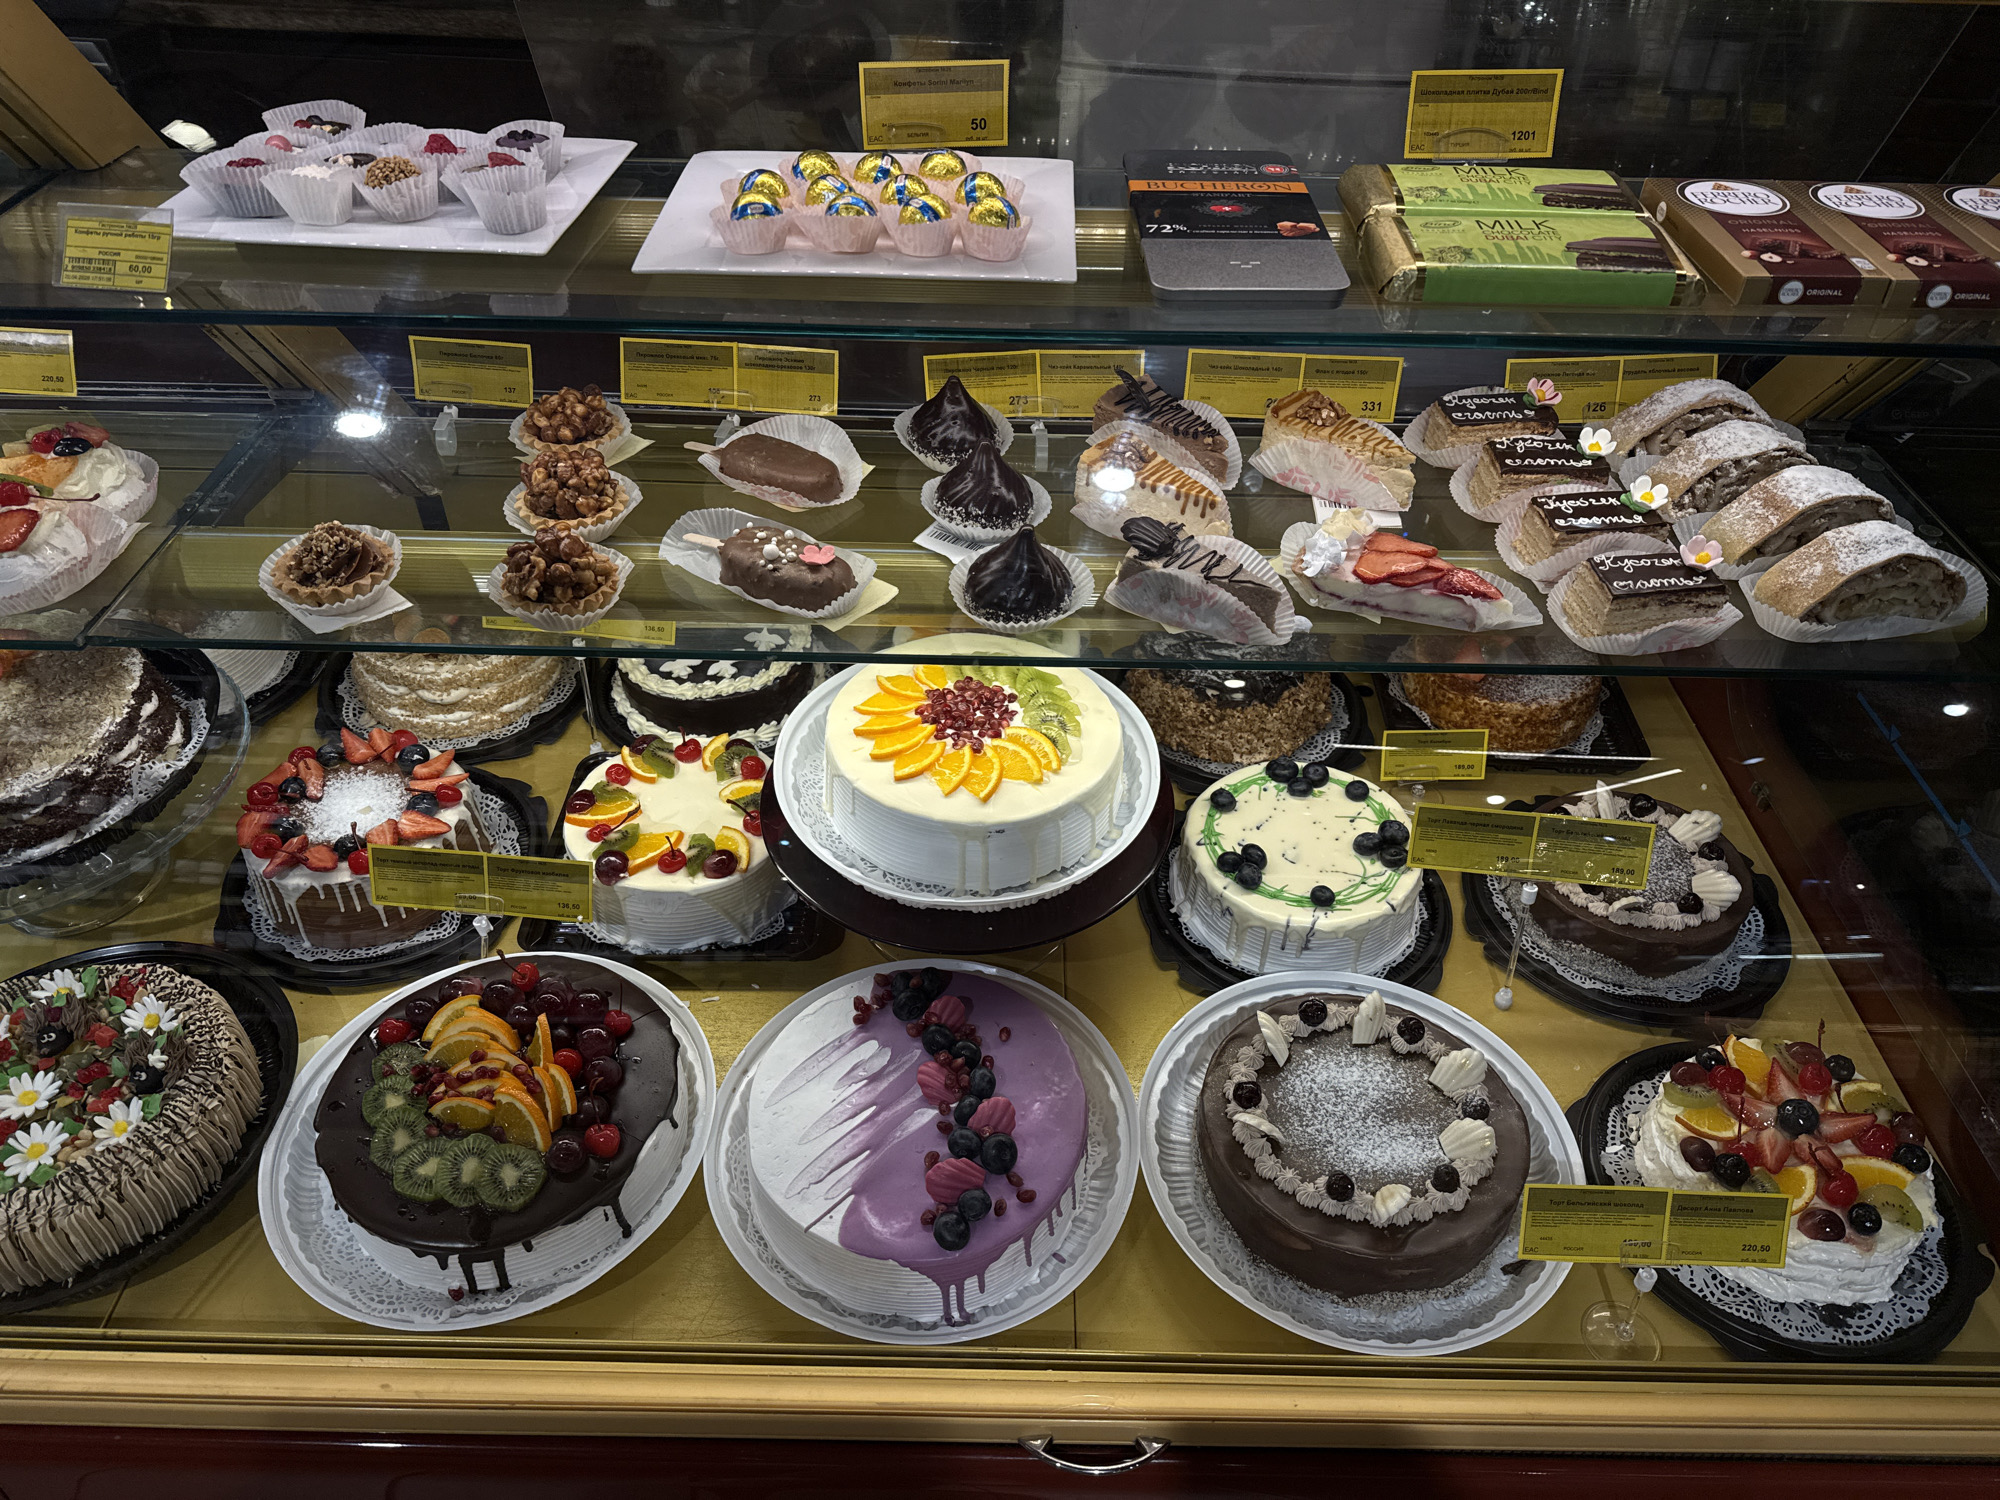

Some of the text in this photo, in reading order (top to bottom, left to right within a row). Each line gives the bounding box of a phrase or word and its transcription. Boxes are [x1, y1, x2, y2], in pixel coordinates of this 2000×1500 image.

[893, 80, 926, 88] Конфеты
[1420, 88, 1465, 97] Шоколадная
[1466, 88, 1491, 96] плитка
[1491, 88, 1514, 97] Дубай
[970, 117, 987, 131] 50
[869, 135, 883, 143] EAC
[1511, 129, 1536, 141] 1201
[1453, 166, 1528, 177] MILK
[1146, 181, 1292, 192] BUCHERON
[1690, 191, 1771, 200] FERRERO
[1823, 194, 1904, 203] FERRERO
[1695, 198, 1780, 206] ROCHER
[1832, 200, 1915, 209] ROCHER
[1145, 224, 1188, 234] 72%
[1474, 219, 1557, 231] MILK
[74, 229, 101, 237] Конфеты
[102, 230, 123, 239] ручной
[128, 264, 152, 274] 60,00
[636, 352, 665, 360] Пирожное
[41, 375, 64, 383] 220,50
[503, 386, 516, 394] 137
[808, 394, 821, 402] 273
[1008, 395, 1029, 406] 273
[1361, 400, 1382, 412] 331
[1586, 401, 1607, 413] 126
[644, 625, 665, 633] 136,50
[1490, 822, 1524, 831] смородина
[1551, 827, 1565, 835] Торт
[1611, 866, 1635, 876] 189,00
[557, 902, 581, 911] 136,50
[1549, 1199, 1566, 1208] Торт
[1566, 1200, 1612, 1208] Бельгийский
[1676, 1204, 1754, 1214] Десерт Анна Павлова
[1741, 1243, 1771, 1253] 220,50
